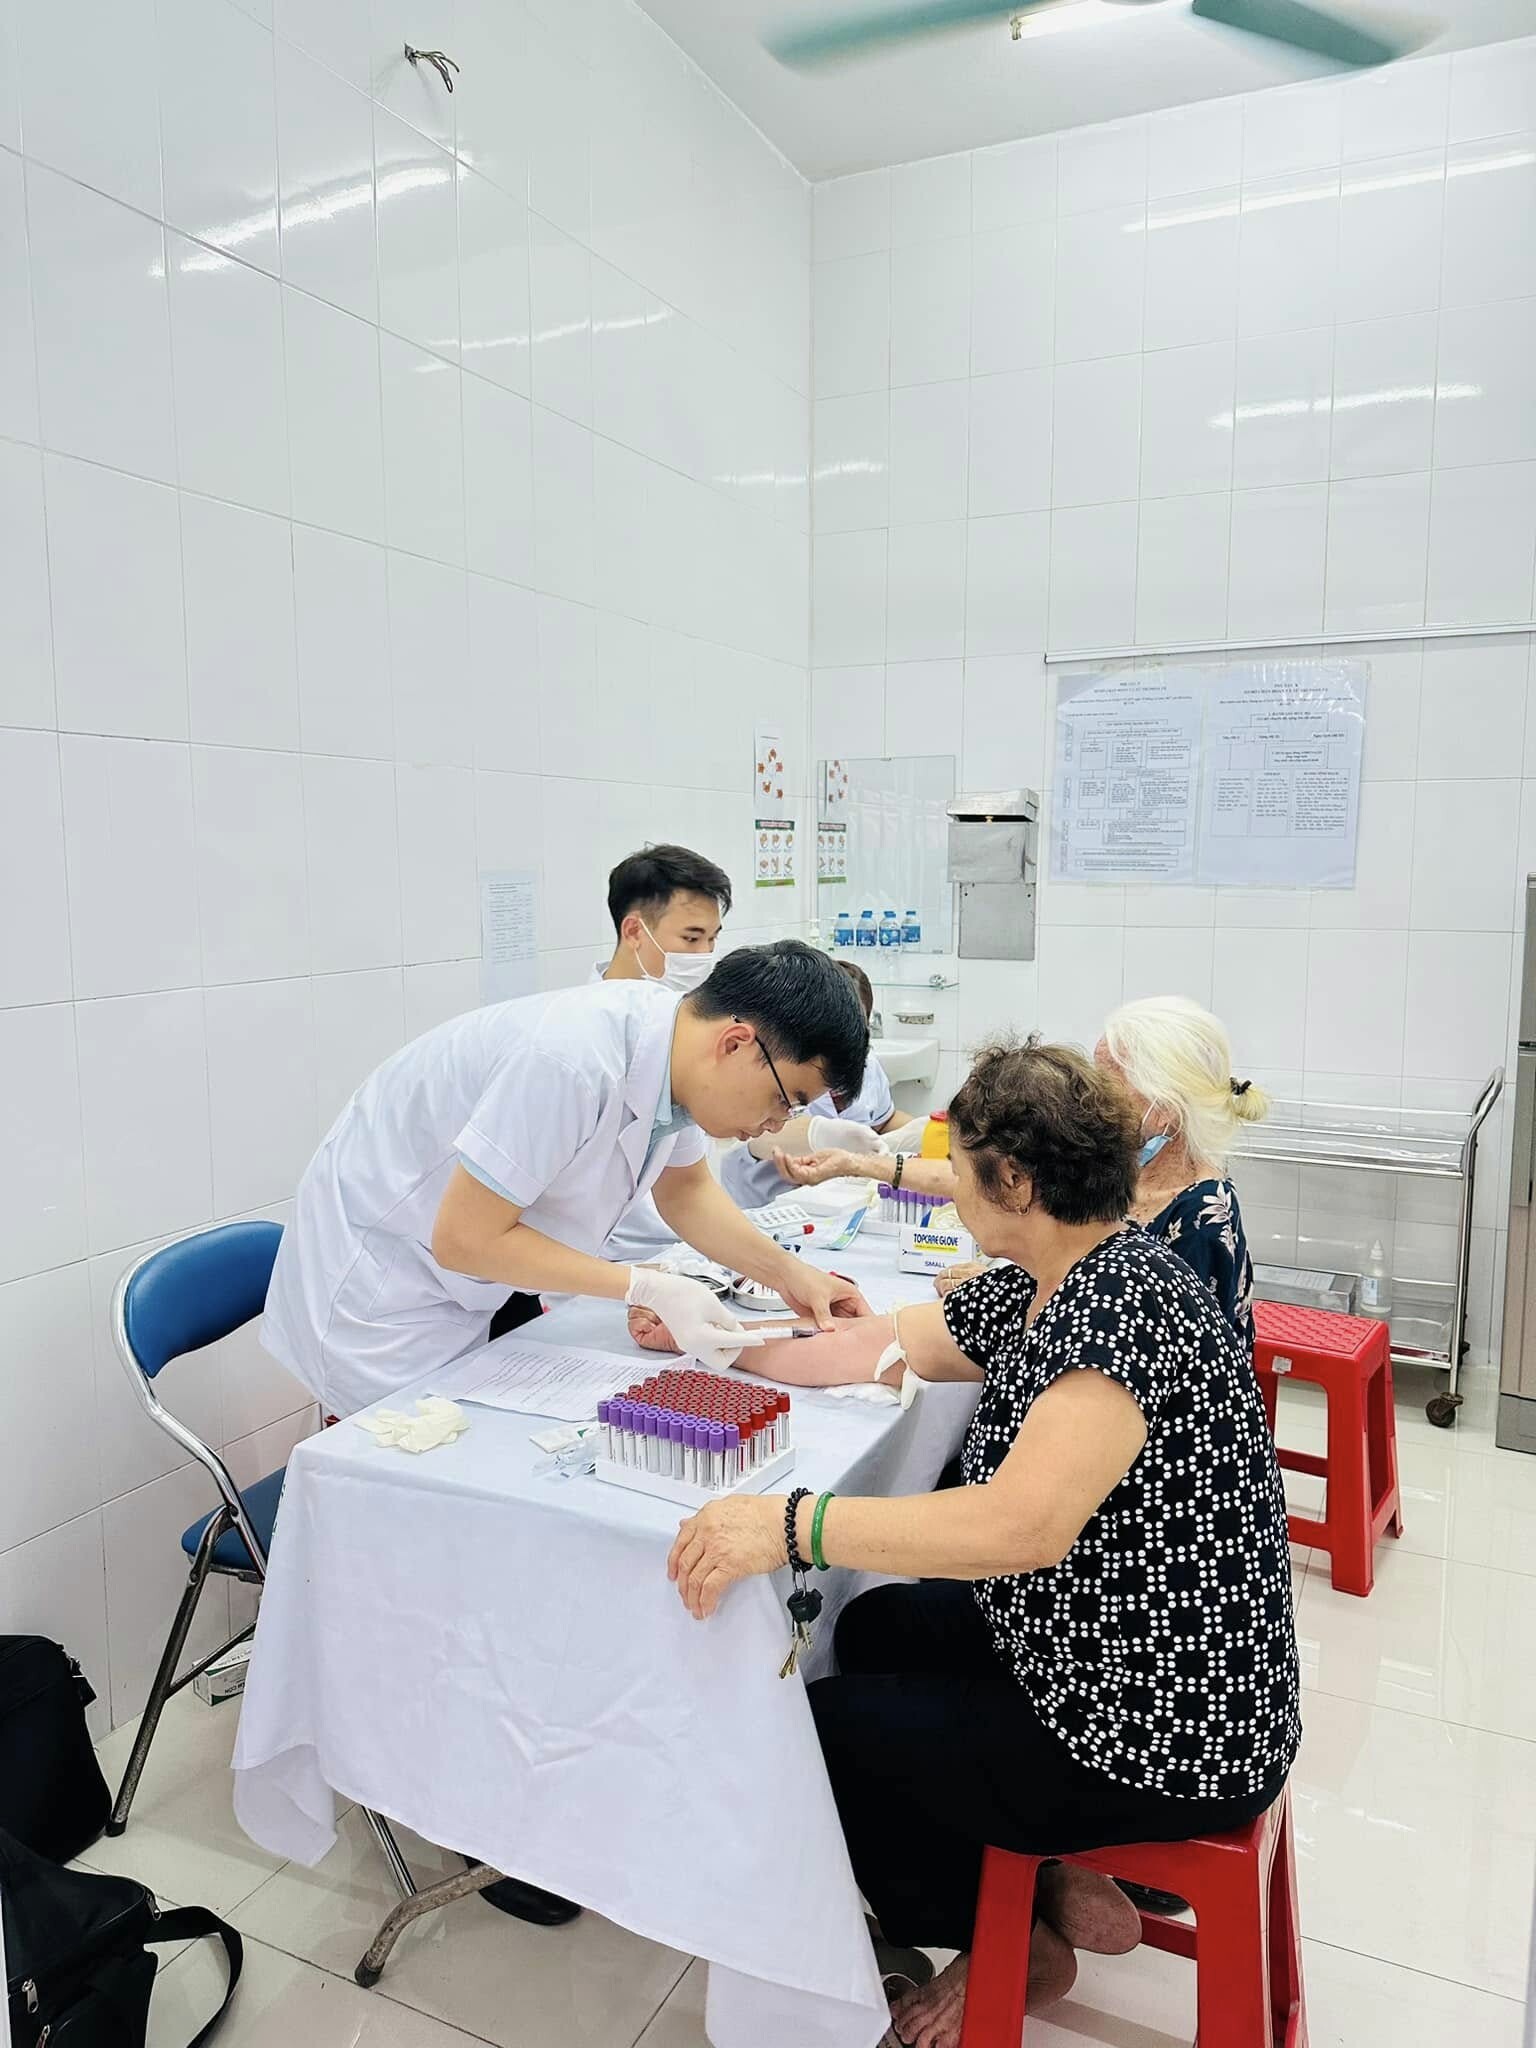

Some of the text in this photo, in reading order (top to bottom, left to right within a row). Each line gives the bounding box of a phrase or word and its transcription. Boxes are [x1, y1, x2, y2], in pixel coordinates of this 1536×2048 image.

[914, 1233, 958, 1246] TOPCARE GLOVE
[924, 1260, 945, 1268] SMALL
